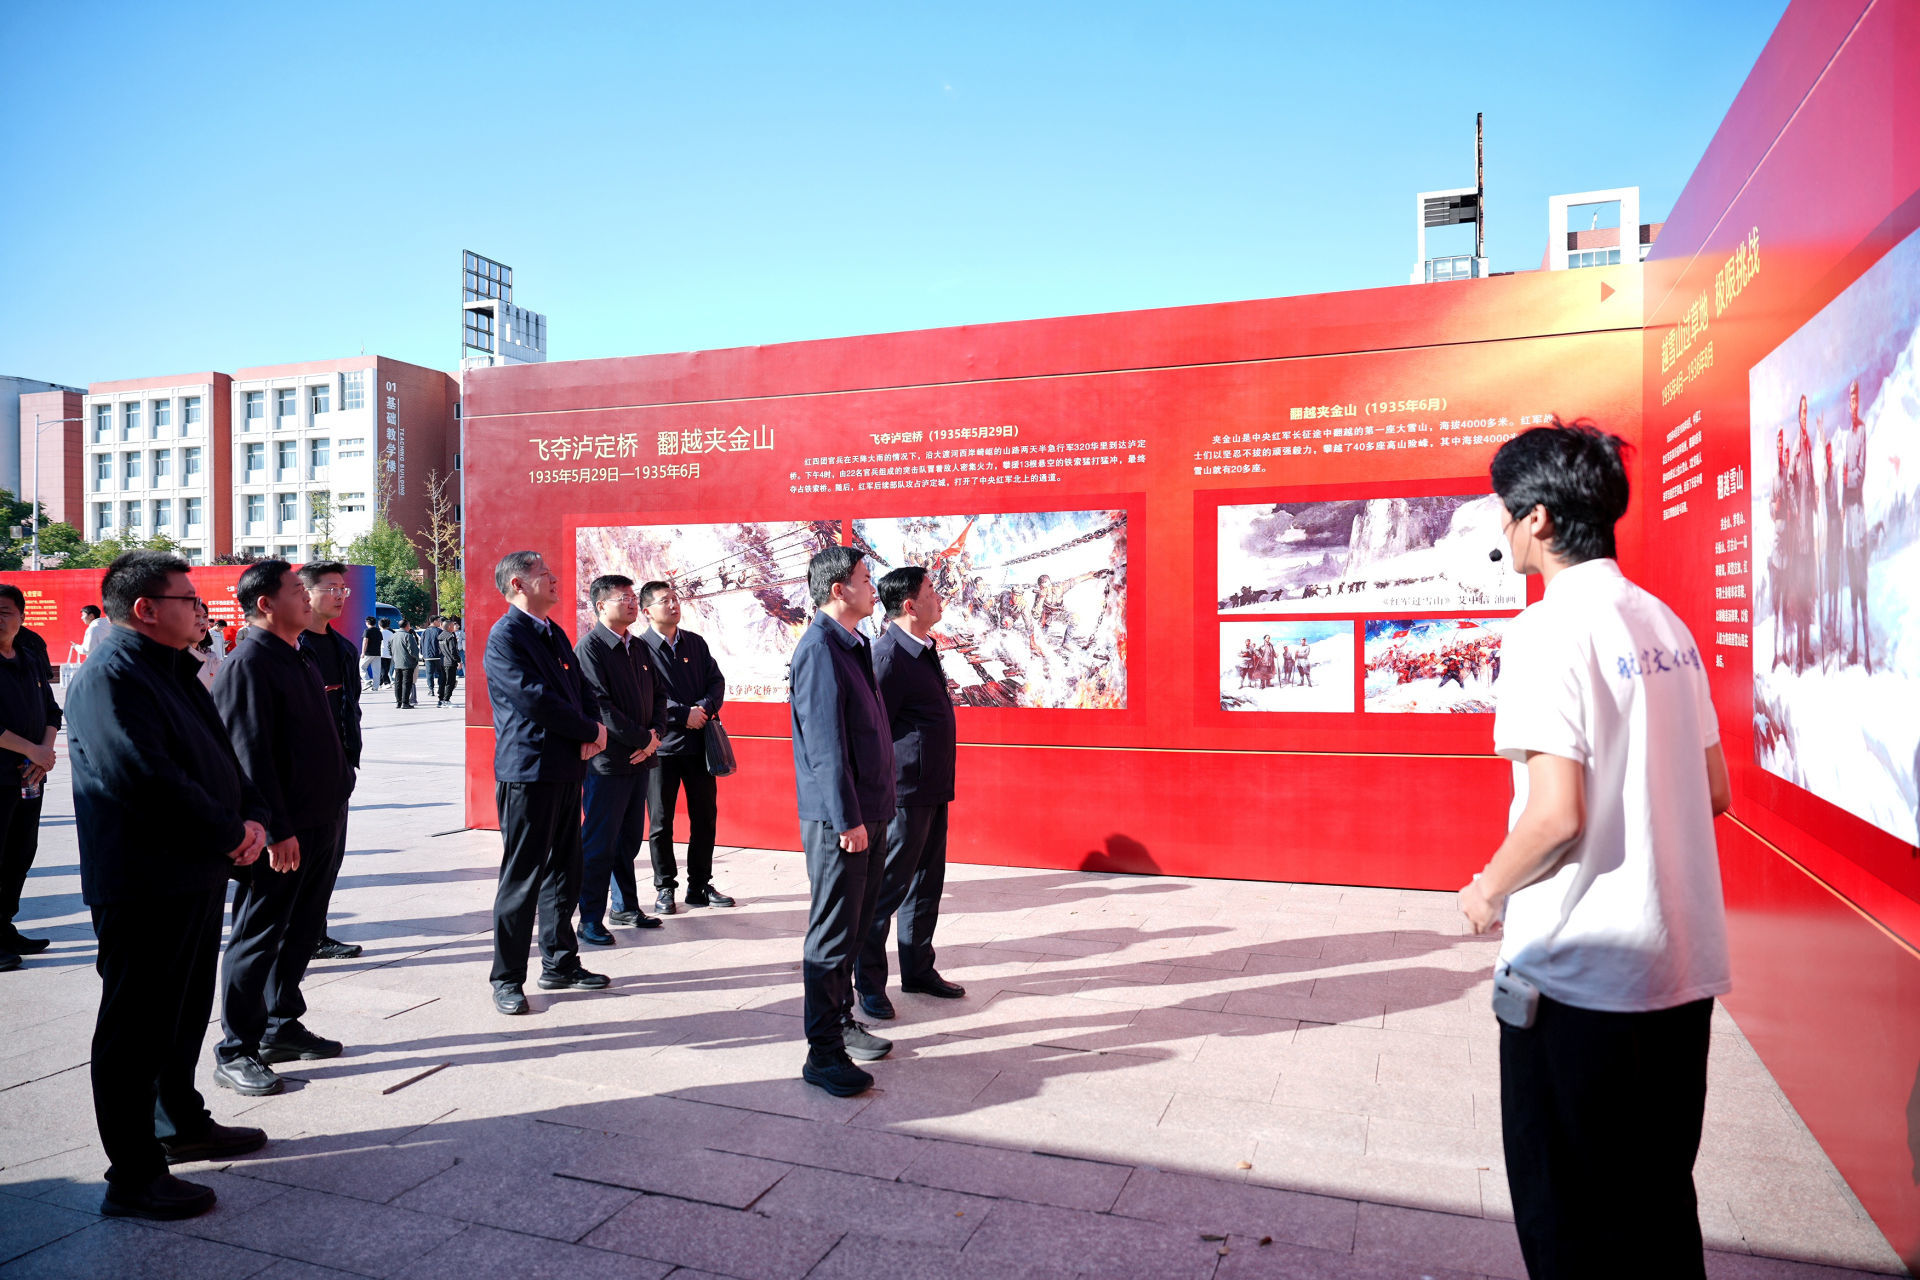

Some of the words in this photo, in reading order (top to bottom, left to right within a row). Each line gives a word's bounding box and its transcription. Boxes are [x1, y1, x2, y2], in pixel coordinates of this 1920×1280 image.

[1714, 225, 1761, 319] 极限挑战
[385, 381, 397, 393] 01
[385, 395, 397, 473] 基础教学楼
[528, 432, 639, 461] 飞夺泸定桥
[656, 424, 775, 456] 翻越夹金山
[528, 463, 701, 484] 1935年5月29日—1935年6月
[1193, 463, 1267, 475] 雪山就有20多座。
